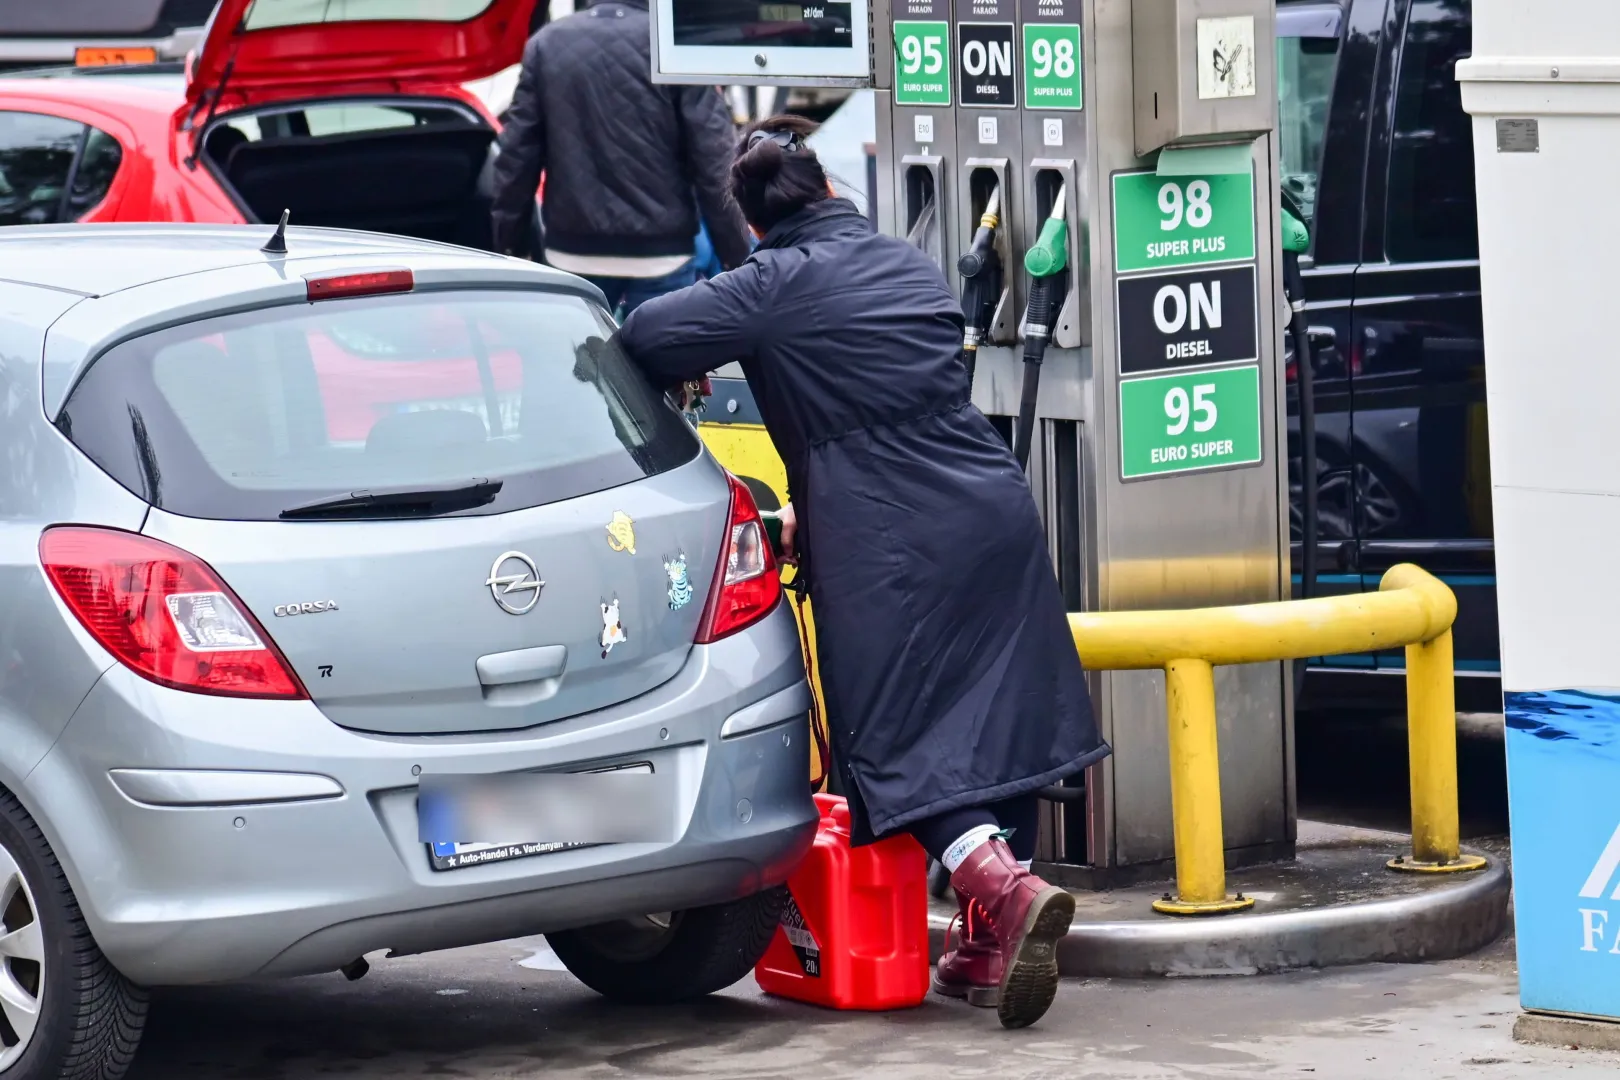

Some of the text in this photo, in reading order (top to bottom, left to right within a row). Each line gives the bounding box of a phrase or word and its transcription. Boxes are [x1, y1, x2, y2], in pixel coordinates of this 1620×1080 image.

[908, 5, 933, 14] FARAON
[973, 6, 998, 15] FARAON
[1038, 7, 1064, 16] FARAON
[901, 35, 943, 75] 95
[963, 40, 1012, 76] ON
[1031, 38, 1075, 78] 98
[903, 83, 943, 93] EURO SUPER
[976, 85, 1000, 95] DIESEL
[1033, 87, 1073, 97] SUPER PLUS
[918, 124, 930, 134] E10
[1157, 179, 1213, 231] 98
[1146, 236, 1226, 259] SUPER PLUS
[1153, 280, 1222, 334] ON
[1165, 340, 1213, 360] DIESEL
[1163, 383, 1218, 436] 95
[1150, 439, 1233, 464] EURO SUPER
[273, 599, 339, 618] CORSA
[459, 848, 508, 865] Auto-Handel
[509, 846, 523, 856] Fa.
[523, 842, 564, 855] Vardanyan
